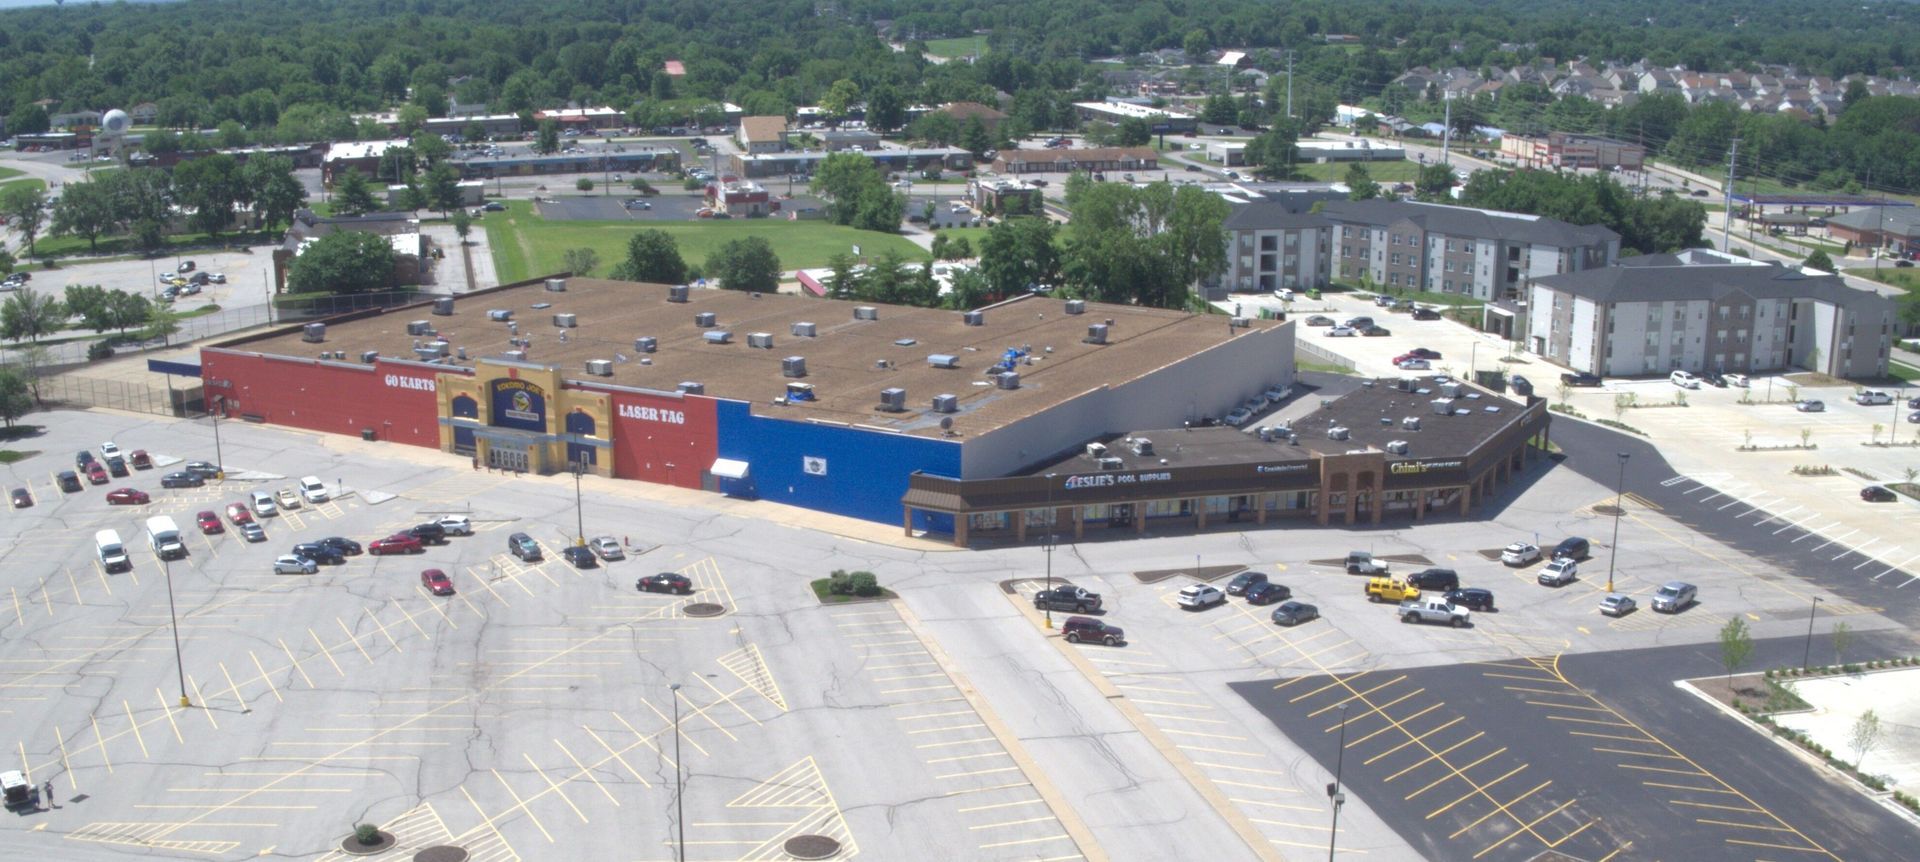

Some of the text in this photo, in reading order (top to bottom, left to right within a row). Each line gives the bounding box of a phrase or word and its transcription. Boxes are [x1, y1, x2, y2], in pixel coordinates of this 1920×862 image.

[385, 374, 435, 391] GO KARTS
[619, 403, 684, 424] LASER TAG
[1070, 472, 1171, 488] LESLIE'S POOL SUPPLIES
